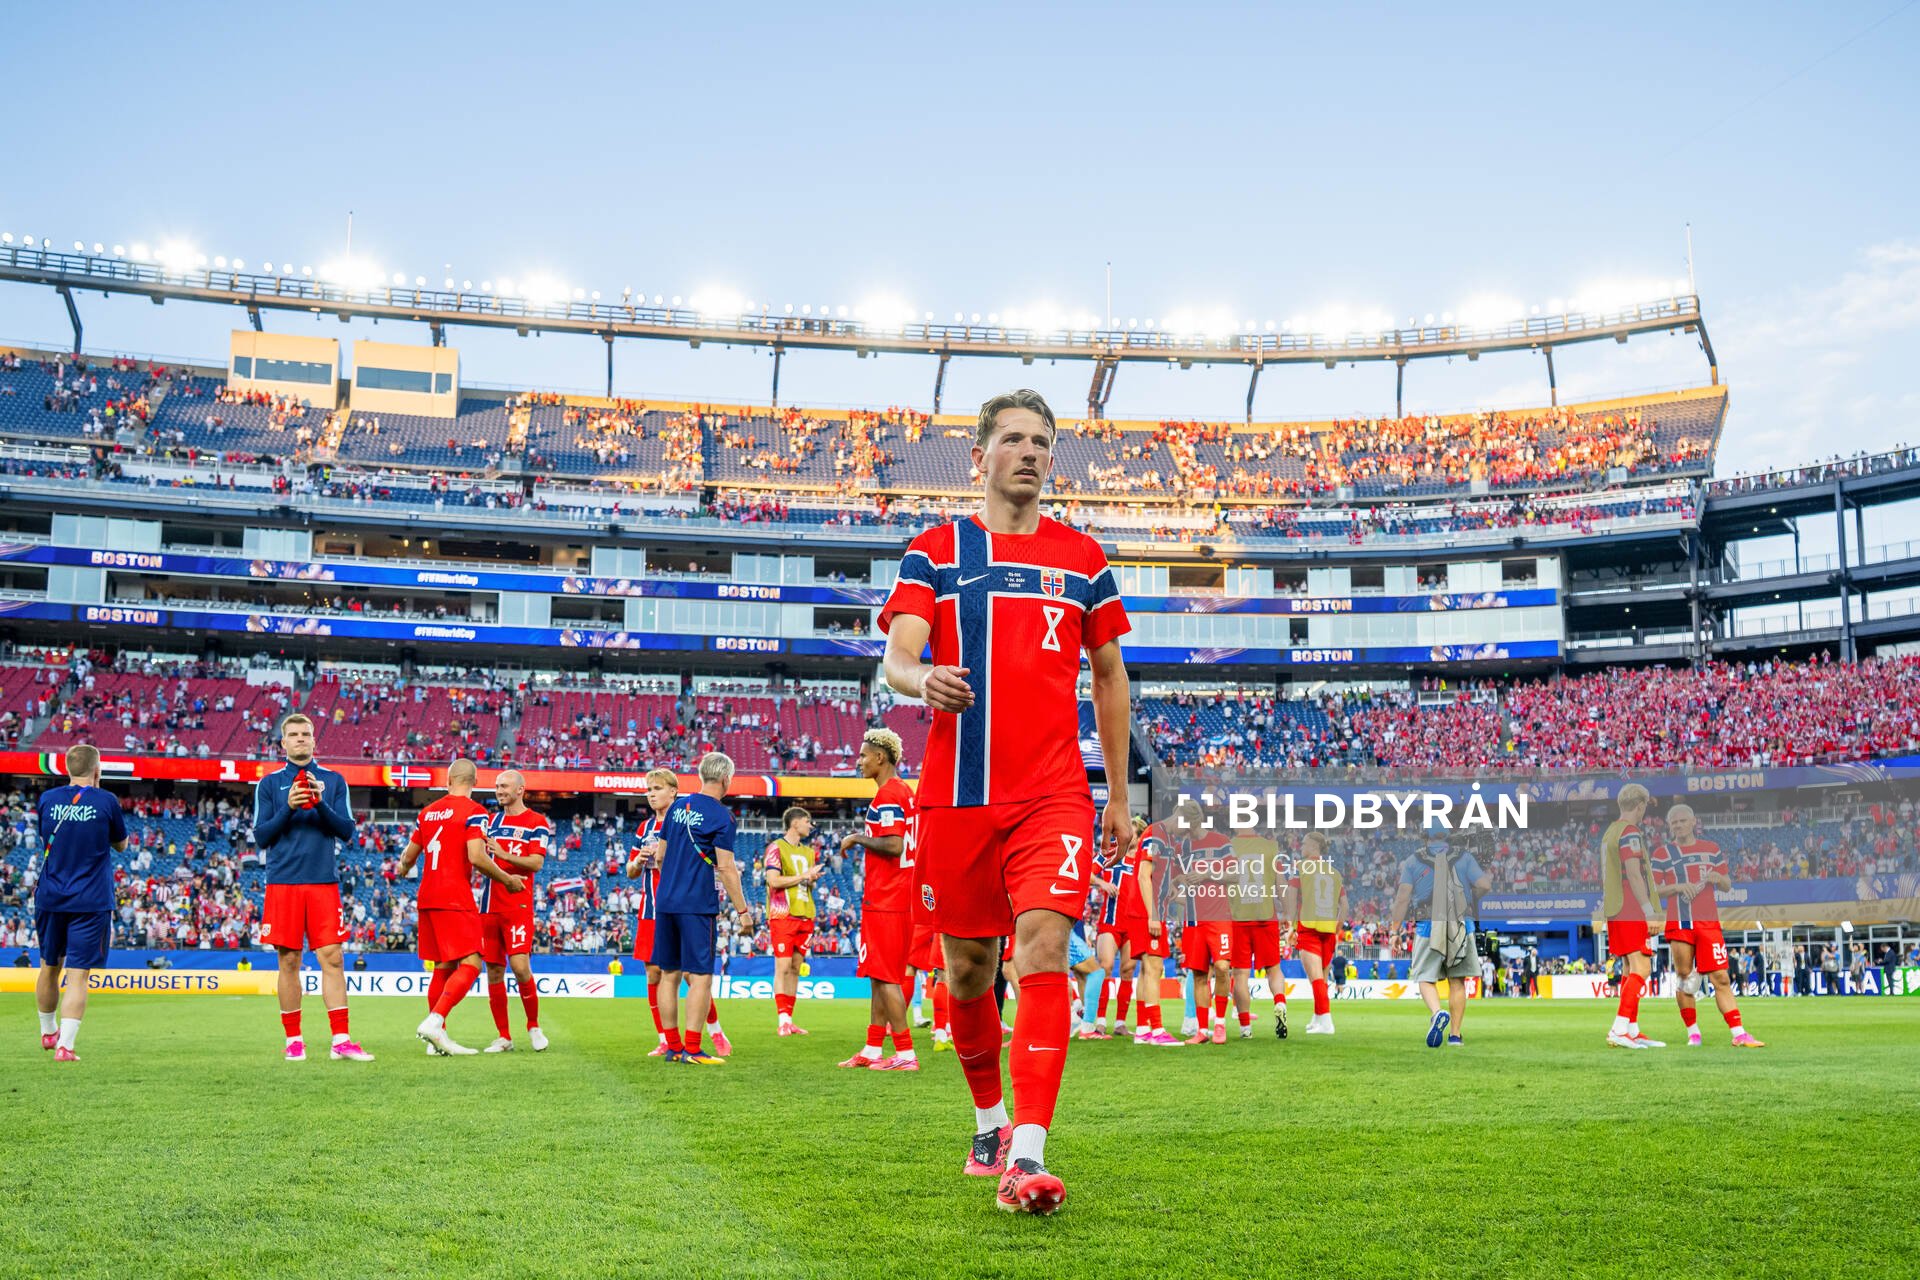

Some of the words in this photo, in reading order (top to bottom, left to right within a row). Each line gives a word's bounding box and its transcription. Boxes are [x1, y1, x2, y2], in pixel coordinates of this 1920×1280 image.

[91, 551, 163, 568] BOSTON
[718, 585, 780, 599] BOSTON
[1291, 599, 1352, 611] BOSTON
[87, 607, 159, 624] BOSTON
[1041, 605, 1065, 652] 8
[716, 637, 779, 651] BOSTON
[1291, 649, 1353, 662] BOSTON
[220, 760, 240, 780] 1
[594, 775, 647, 788] NORWA
[1687, 773, 1764, 791] BOSTON
[427, 825, 443, 870] 4
[1058, 833, 1083, 880] 8
[1482, 901, 1501, 910] FIFA
[1501, 901, 1534, 910] WORLD
[1535, 900, 1553, 909] CUP
[511, 925, 527, 942] 14
[1221, 934, 1229, 949] 5
[306, 975, 384, 992] BNK
[396, 976, 431, 992] OF
[711, 975, 835, 998] isese
